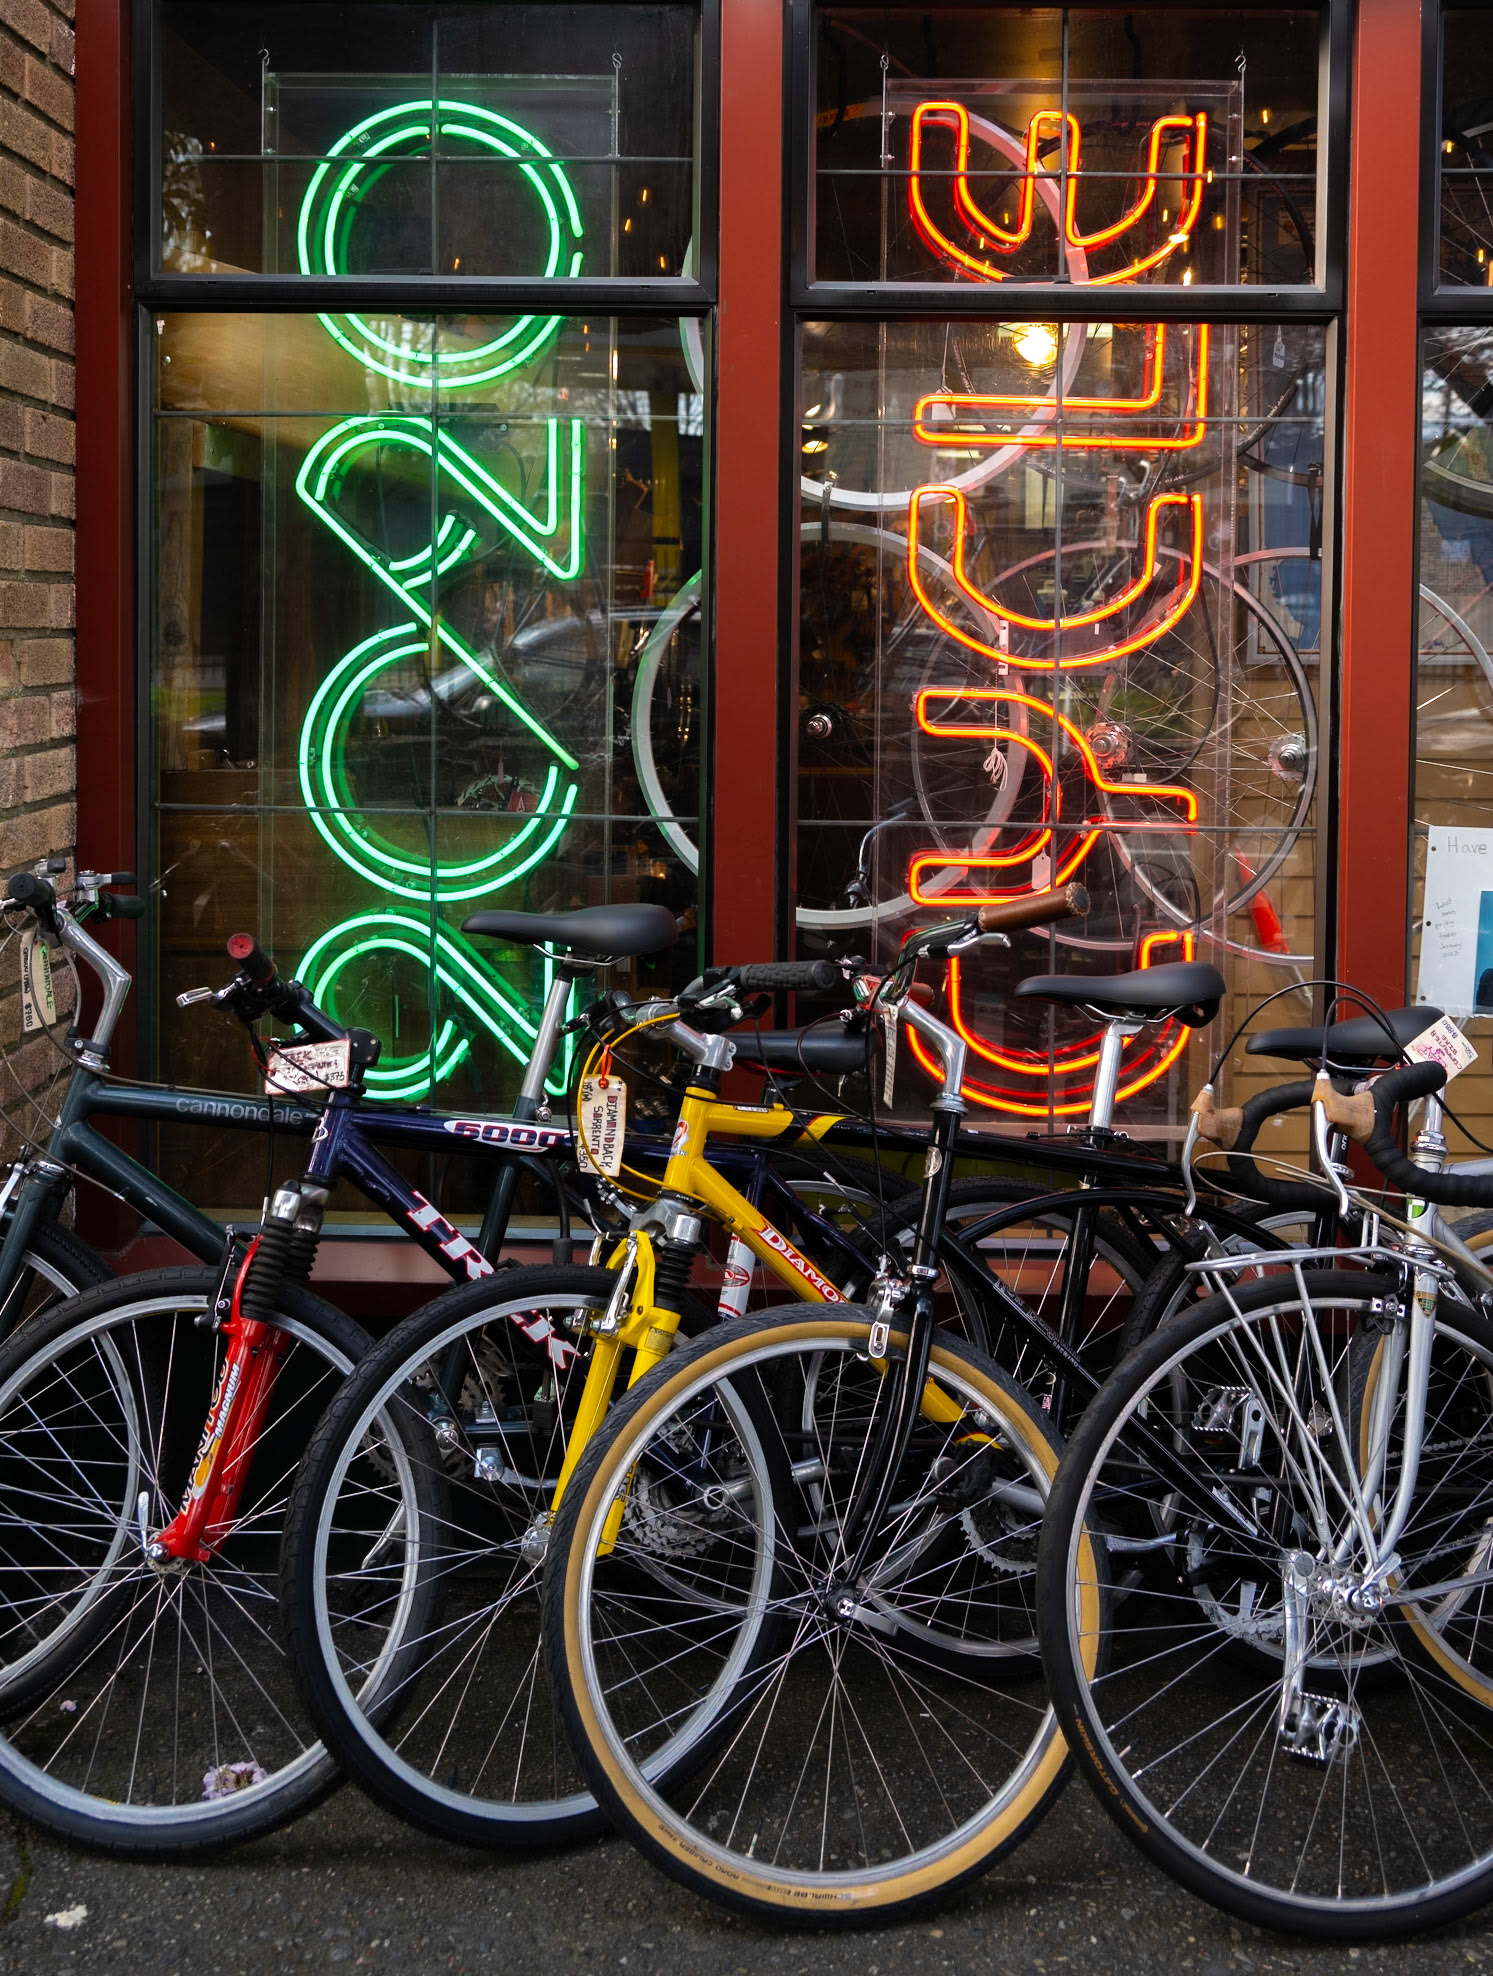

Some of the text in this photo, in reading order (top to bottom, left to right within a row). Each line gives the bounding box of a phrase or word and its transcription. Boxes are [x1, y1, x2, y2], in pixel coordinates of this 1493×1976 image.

[908, 100, 1208, 1117] CYCLE
[1447, 836, 1487, 854] Have
[175, 1098, 303, 1125] cannondale
[453, 1121, 560, 1148] 6000
[407, 1190, 583, 1370] TRK
[1051, 1340, 1079, 1368] BREWING
[214, 1362, 241, 1439] MAGNUM
